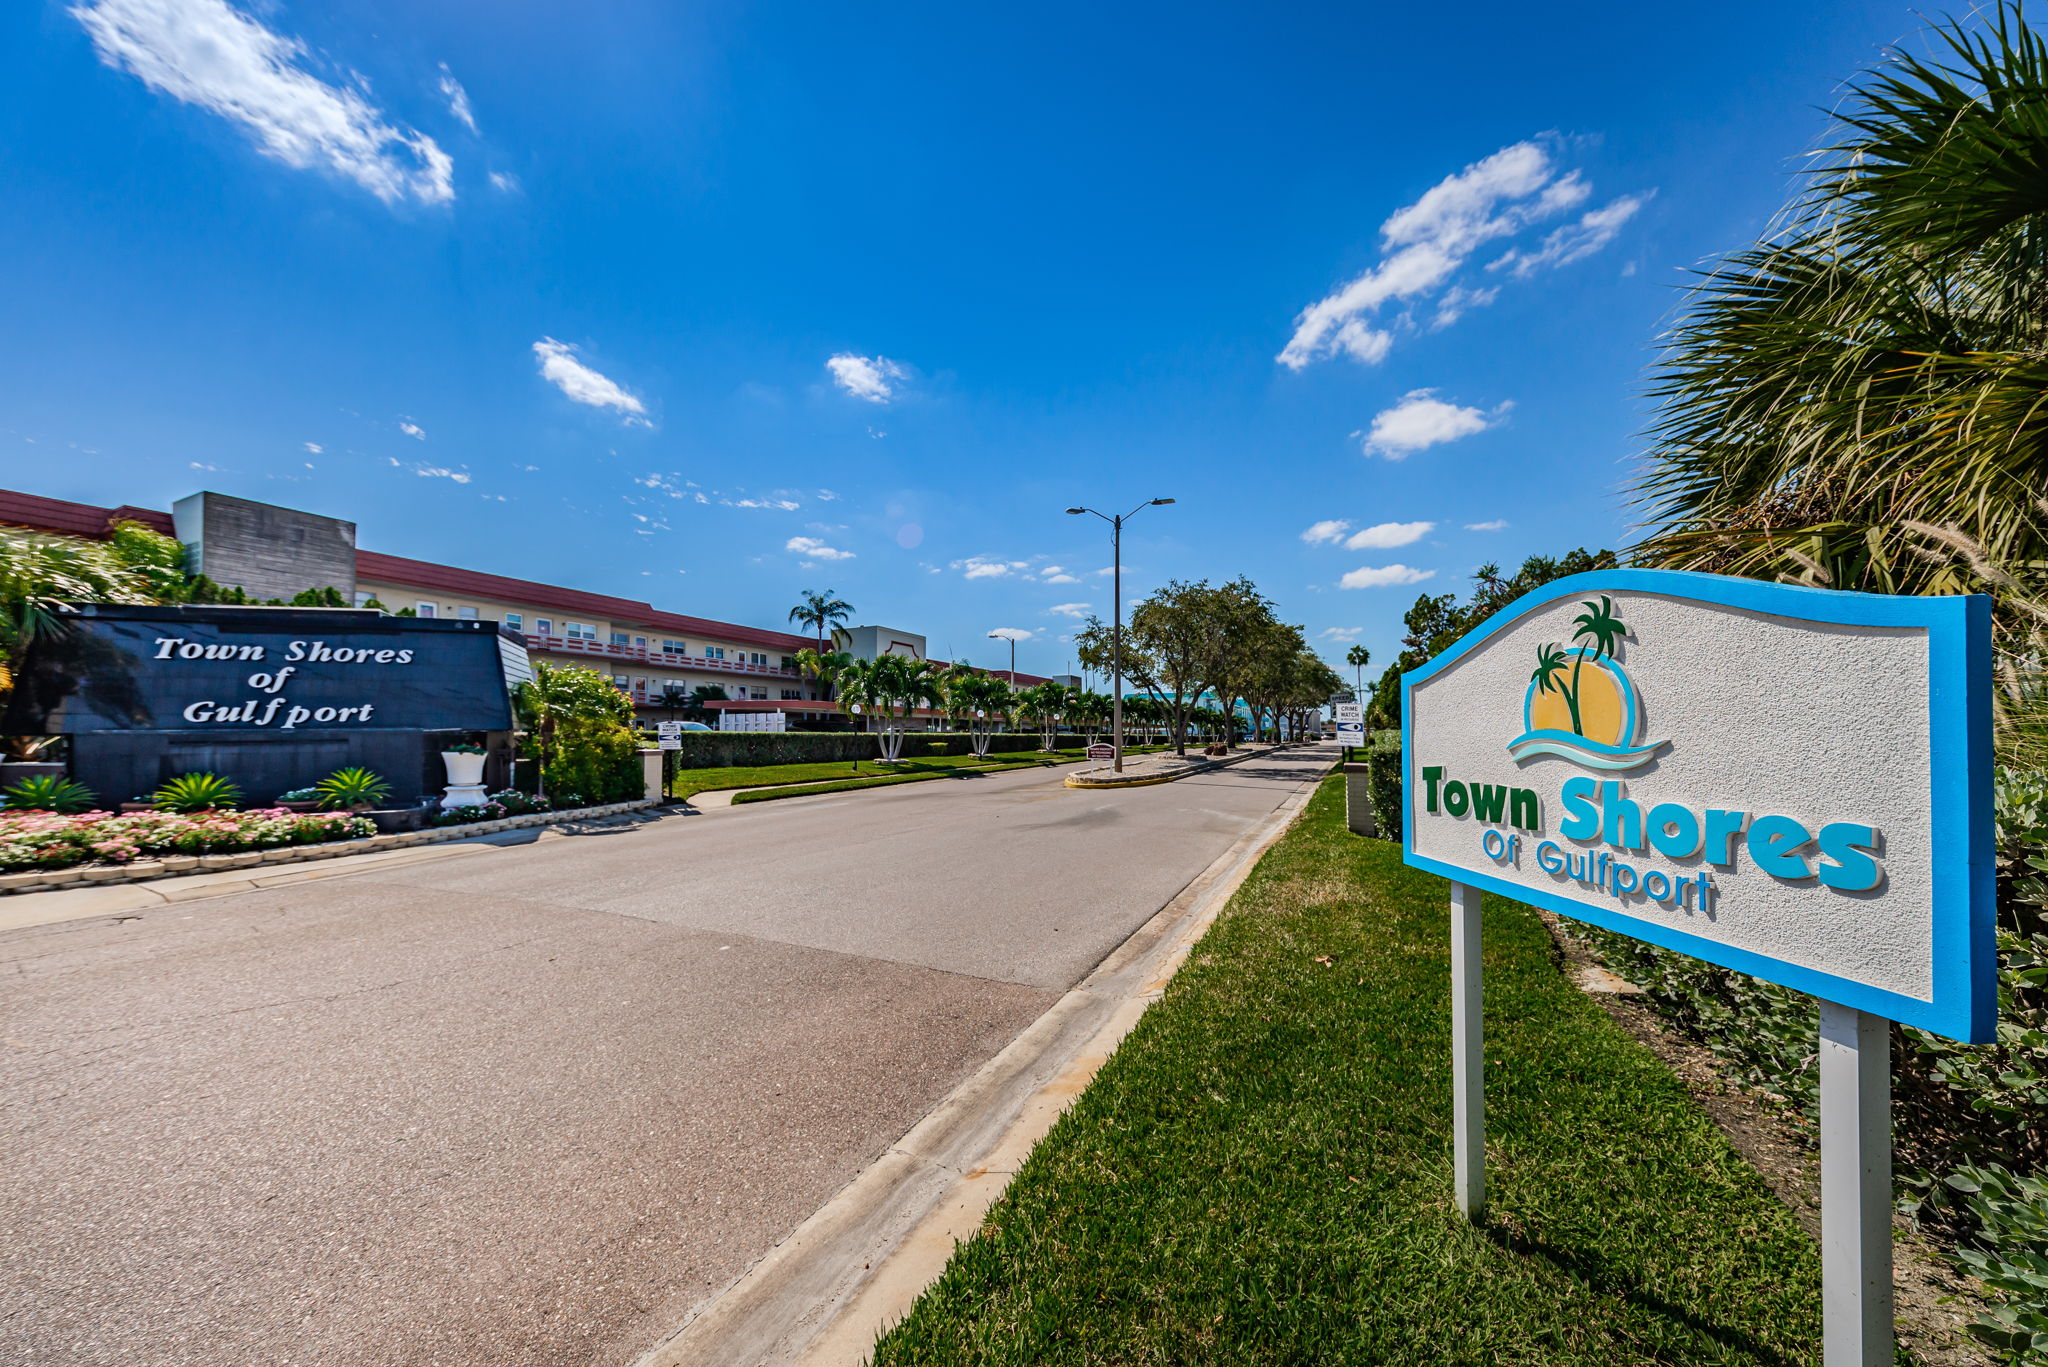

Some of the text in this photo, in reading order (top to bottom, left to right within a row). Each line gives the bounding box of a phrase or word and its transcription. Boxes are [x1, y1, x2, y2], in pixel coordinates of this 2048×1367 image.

[154, 637, 414, 664] Town Shores
[247, 666, 296, 694] of
[183, 697, 375, 729] Gulfport
[1422, 765, 1884, 891] Town Shores
[1482, 829, 1716, 912] Of Gulfport
